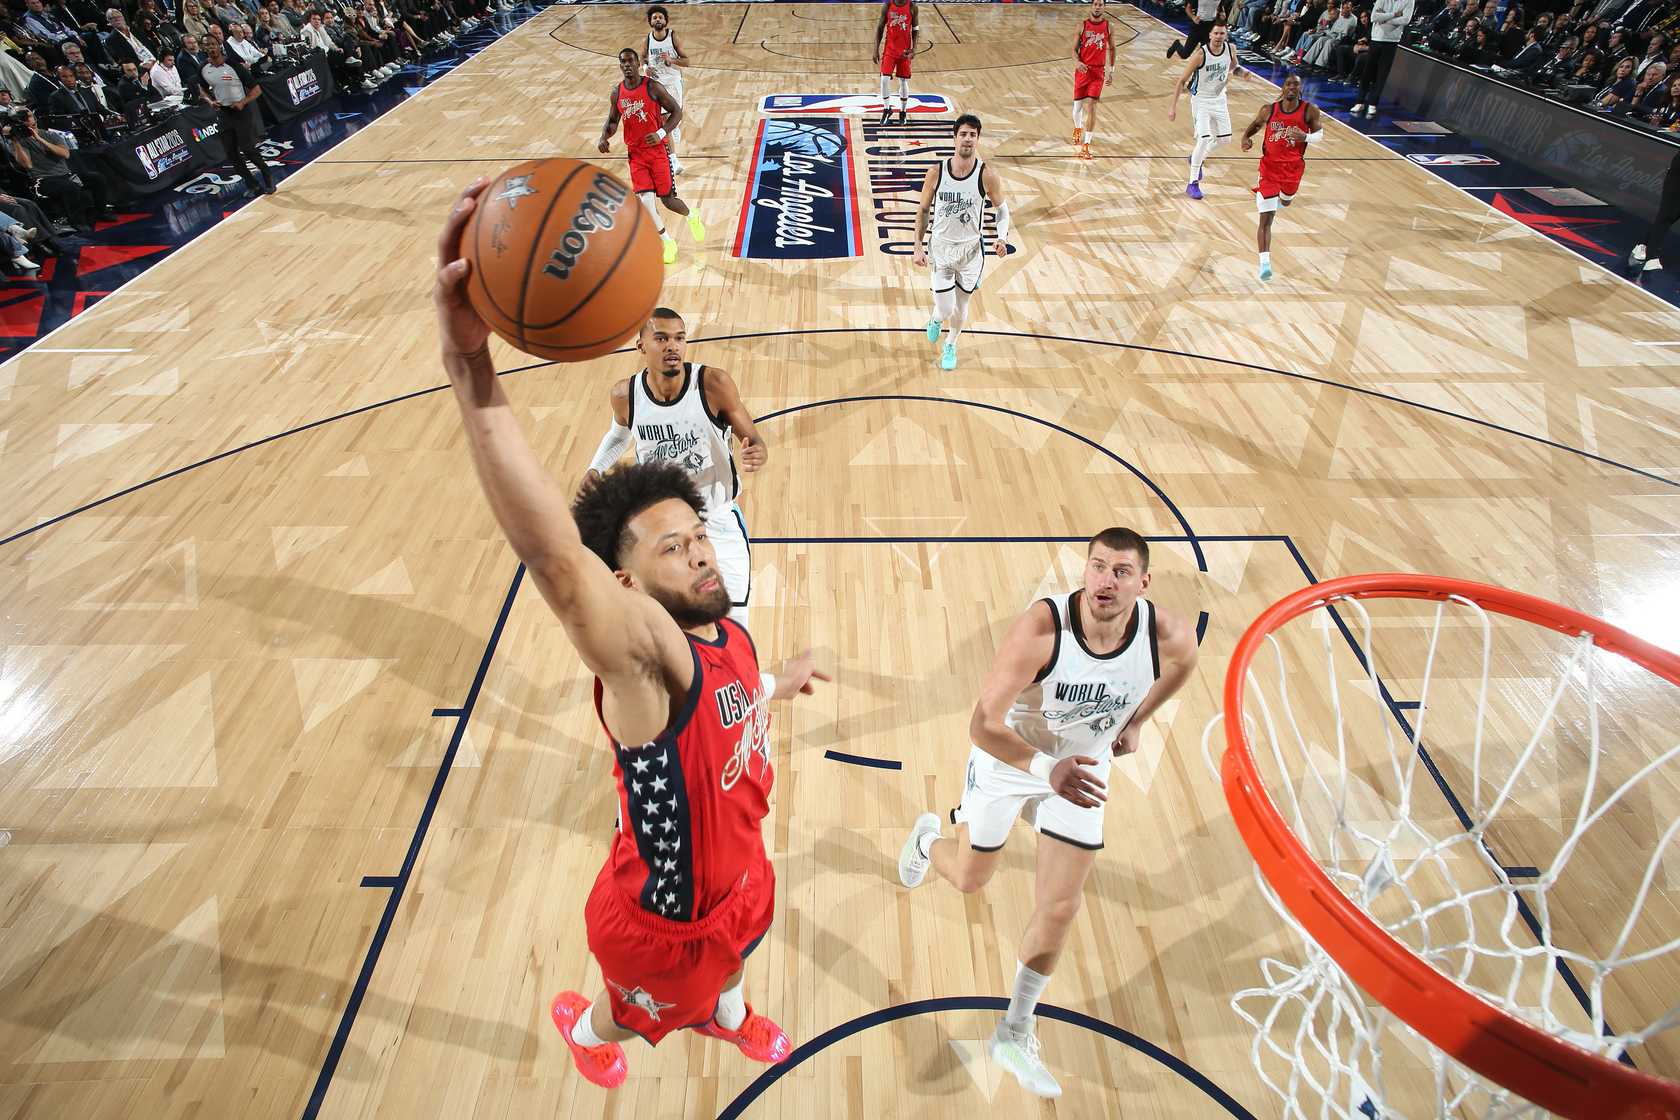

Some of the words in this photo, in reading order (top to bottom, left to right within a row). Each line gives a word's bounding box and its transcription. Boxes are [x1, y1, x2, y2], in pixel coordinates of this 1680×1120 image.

[202, 123, 219, 138] NBC
[783, 151, 835, 177] Los
[939, 191, 961, 202] WORLD
[757, 178, 835, 248] Angeles
[542, 172, 630, 280] Wilson
[637, 424, 674, 441] WORLD
[1055, 682, 1106, 702] WORLD
[715, 679, 751, 729] USA
